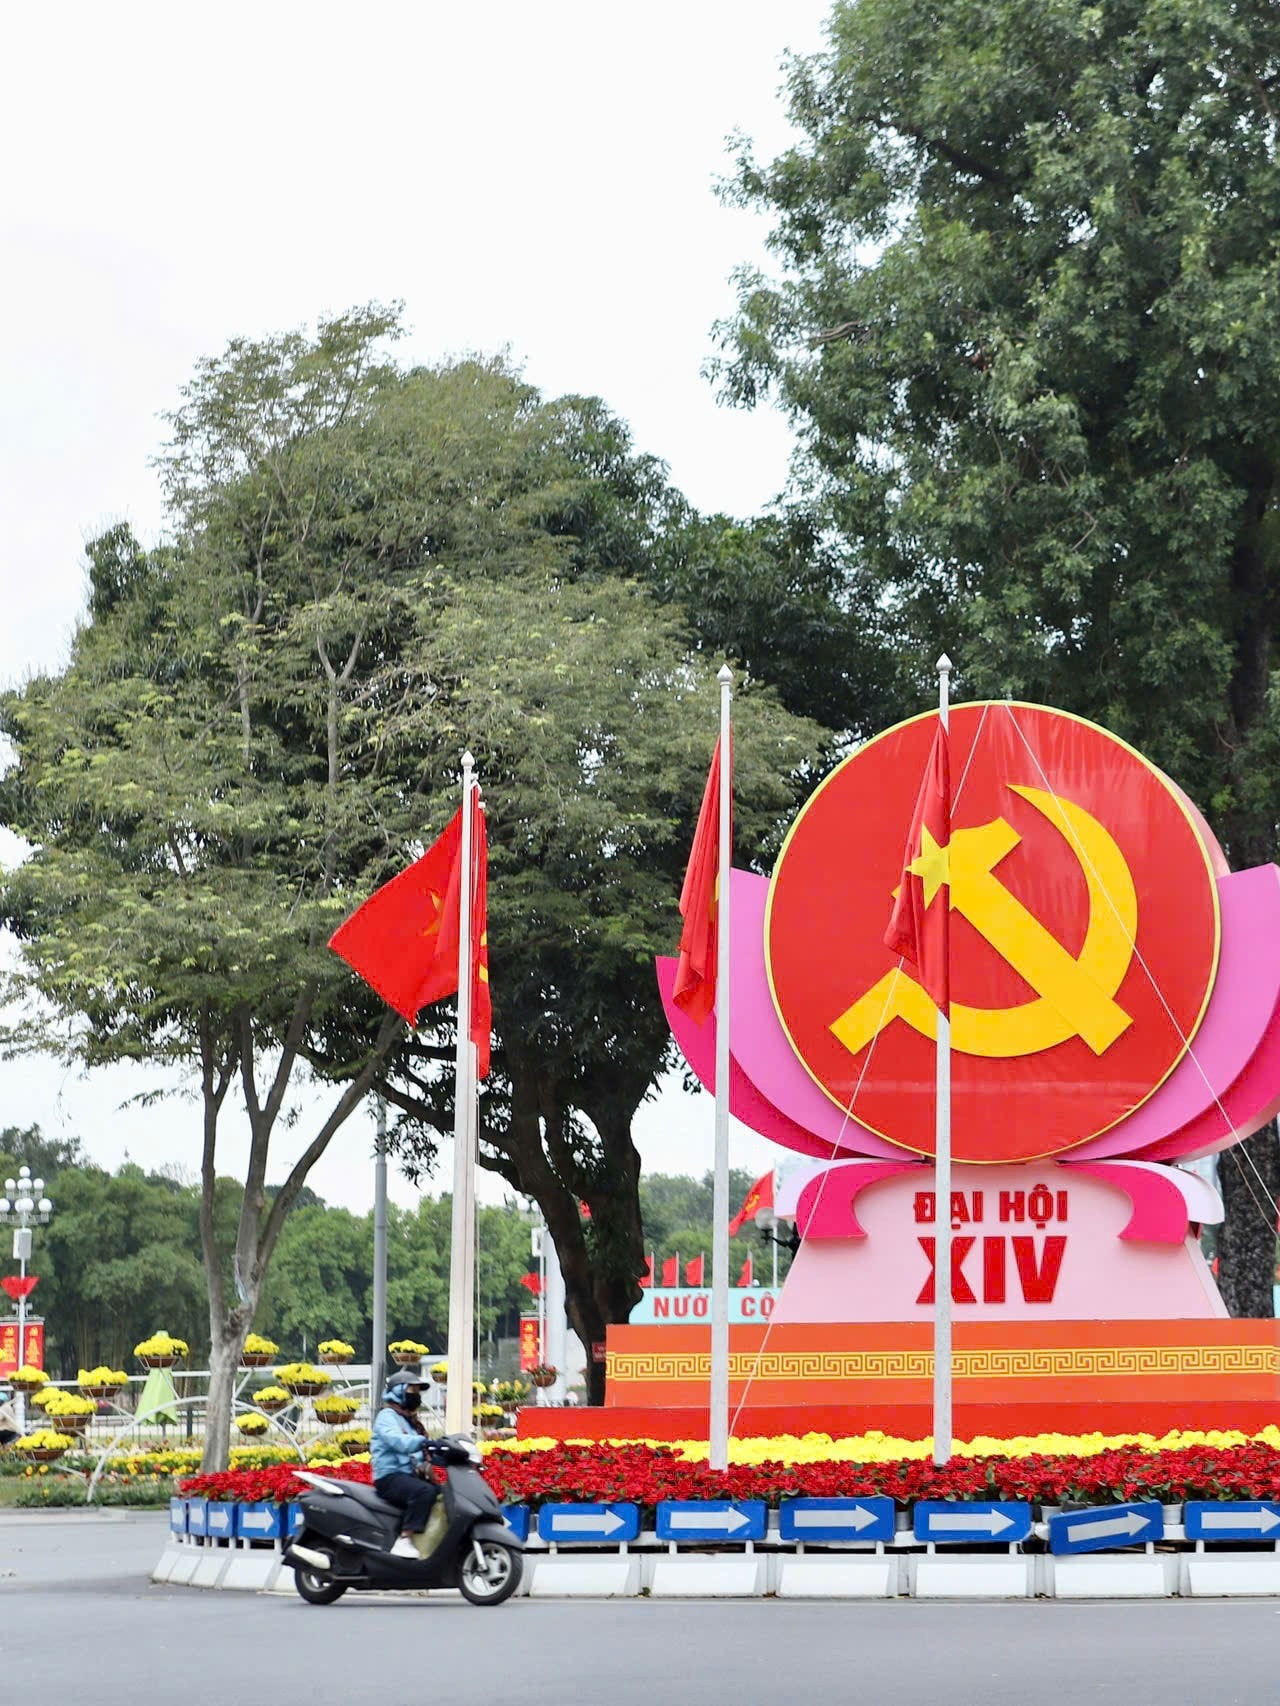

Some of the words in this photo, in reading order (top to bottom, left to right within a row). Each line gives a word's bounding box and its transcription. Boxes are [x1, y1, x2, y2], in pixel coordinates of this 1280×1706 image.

[913, 1191, 983, 1230] ĐẠI
[999, 1183, 1068, 1229] HỘI
[915, 1236, 1067, 1304] XIV
